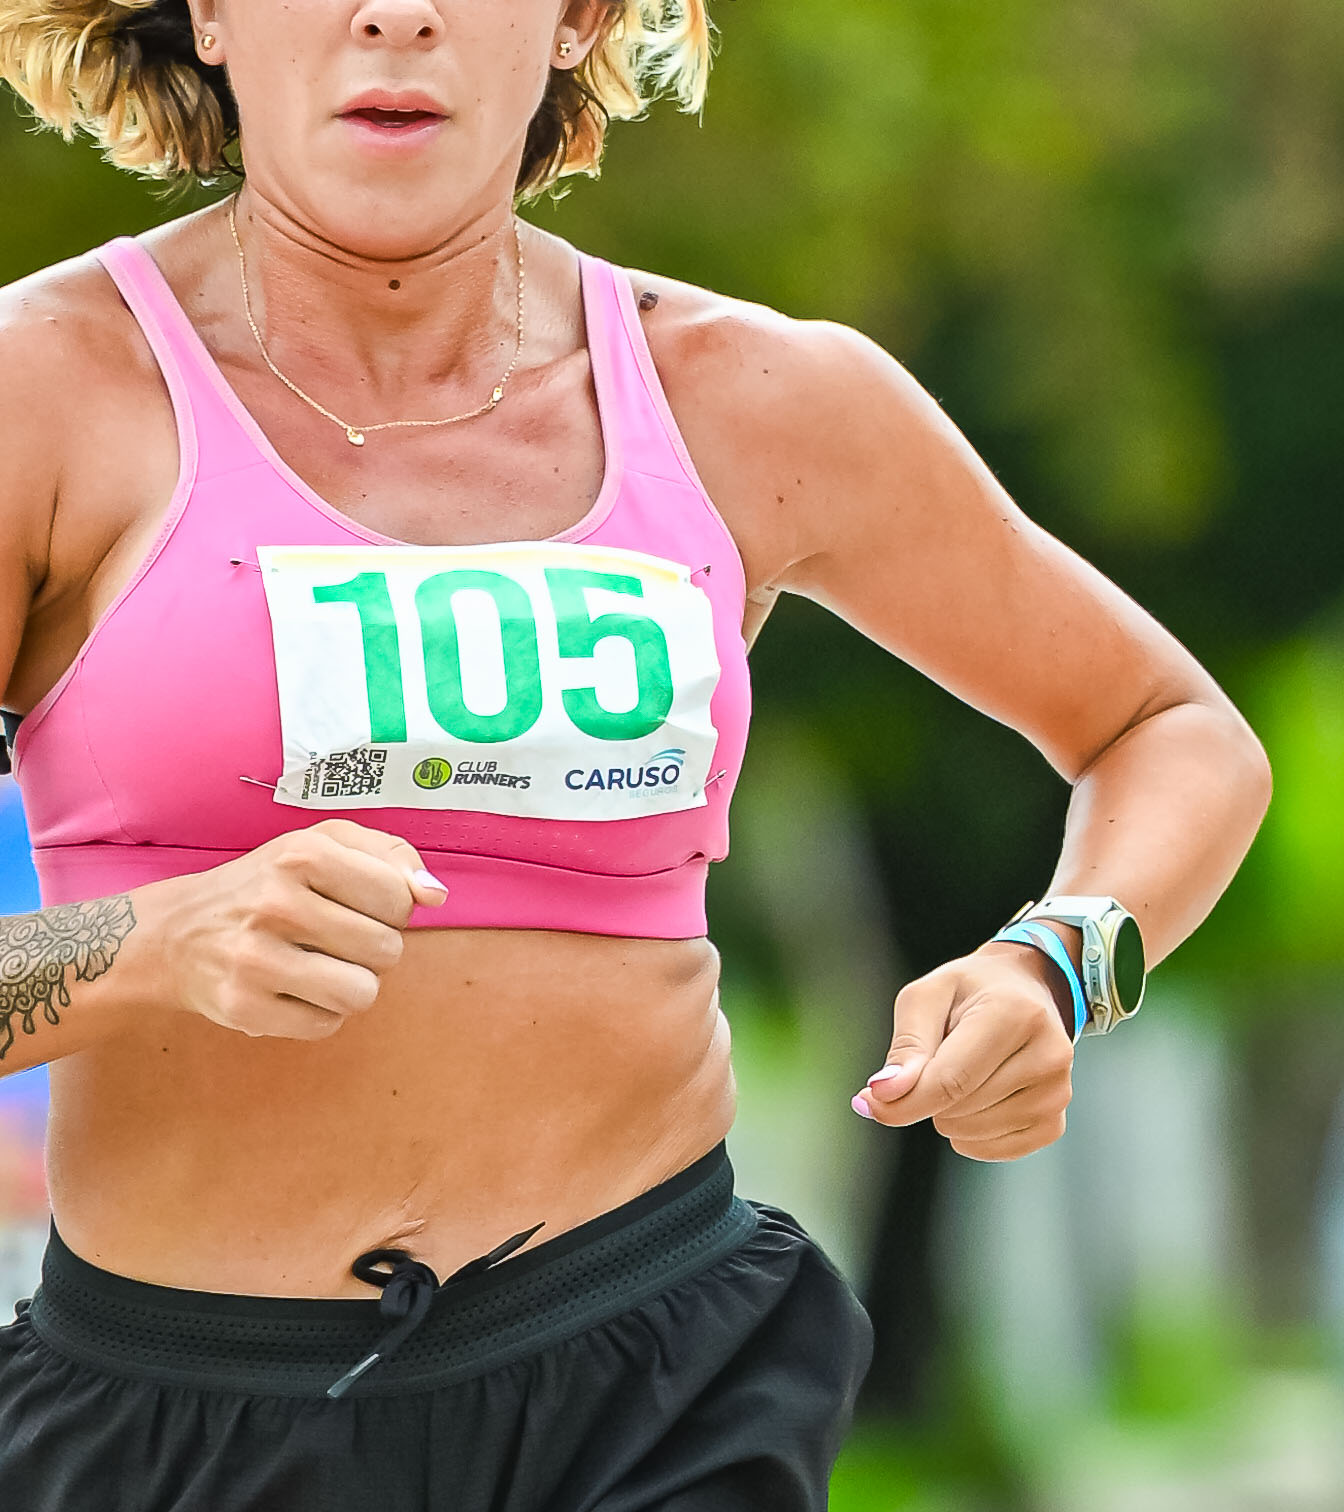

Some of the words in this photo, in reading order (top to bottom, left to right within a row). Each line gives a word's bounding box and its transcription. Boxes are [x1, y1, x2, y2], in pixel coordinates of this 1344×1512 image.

[312, 568, 674, 743] 105
[457, 761, 498, 773] CLUB
[564, 764, 680, 790] CARUSO
